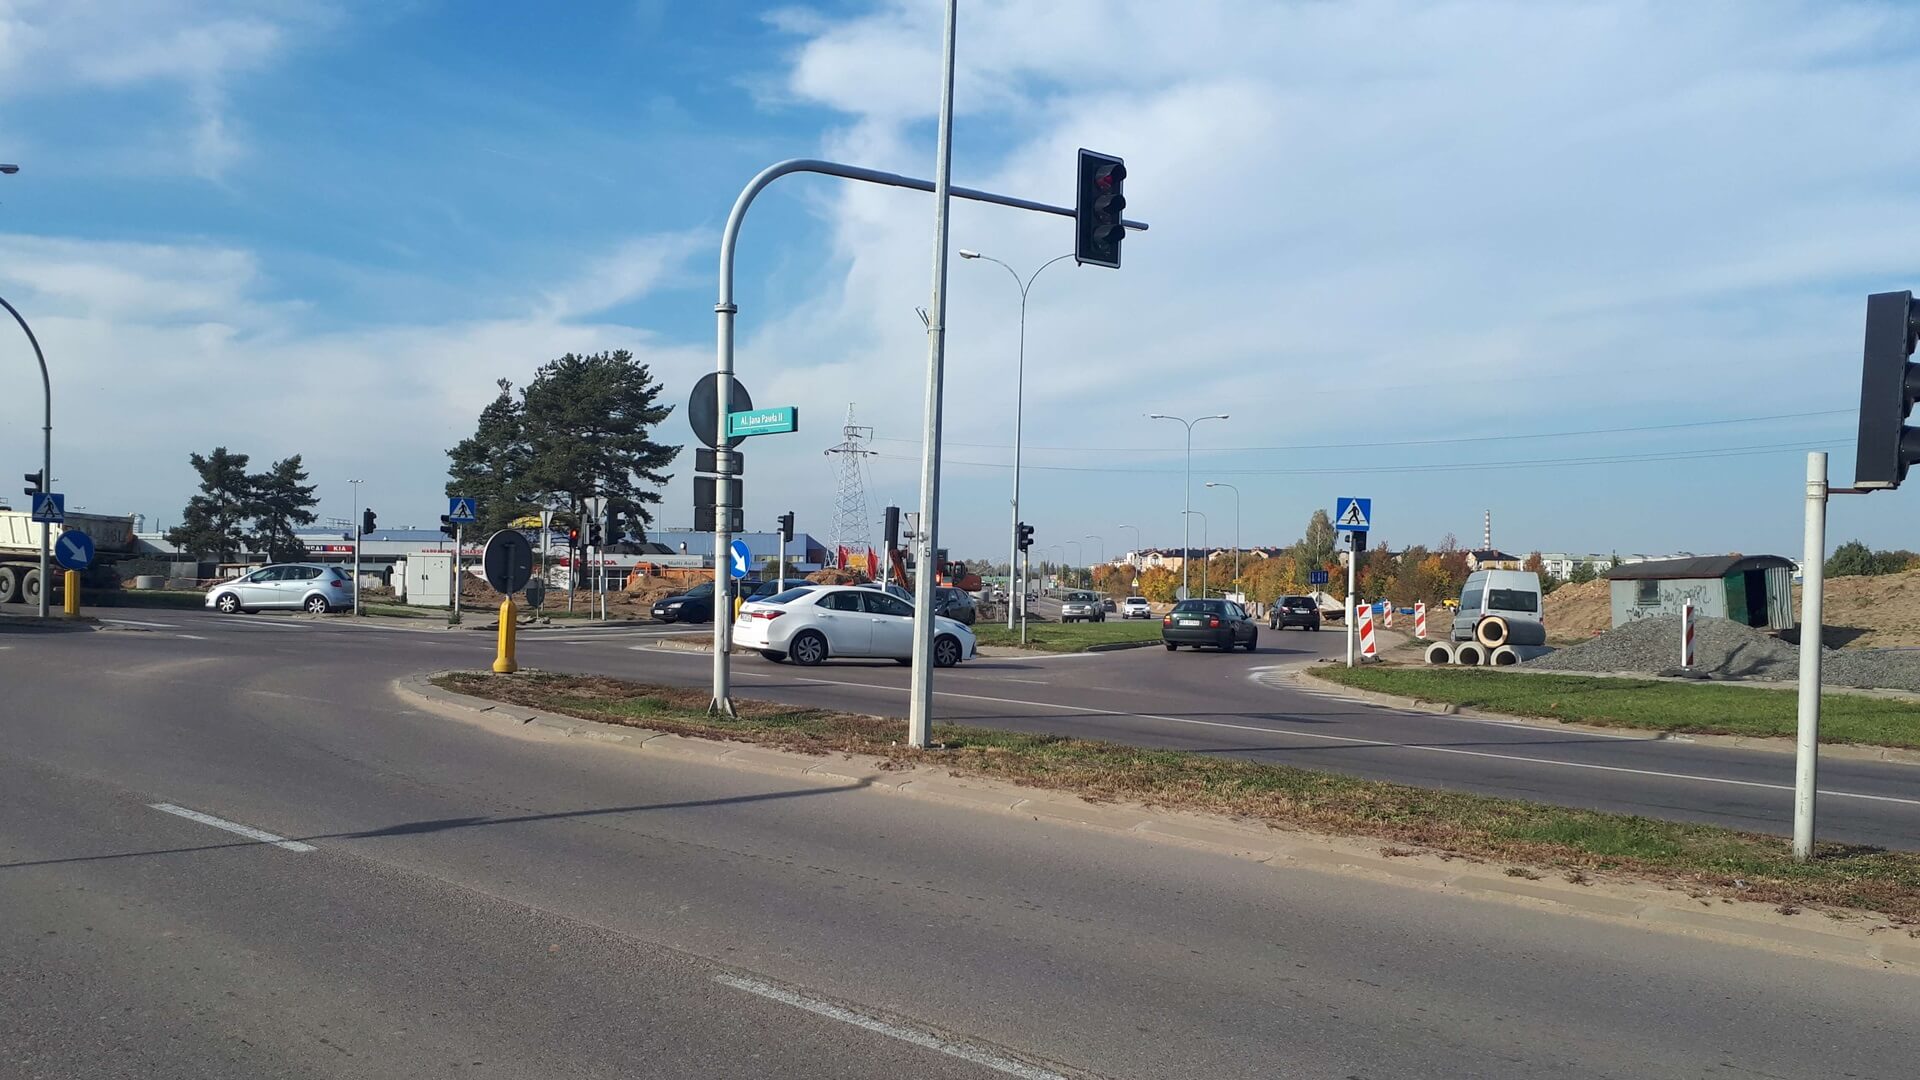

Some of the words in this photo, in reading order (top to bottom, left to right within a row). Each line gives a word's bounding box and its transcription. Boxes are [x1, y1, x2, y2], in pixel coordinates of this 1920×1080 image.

[749, 416, 760, 425] Jana
[762, 412, 777, 424] Pawła
[778, 412, 782, 422] II
